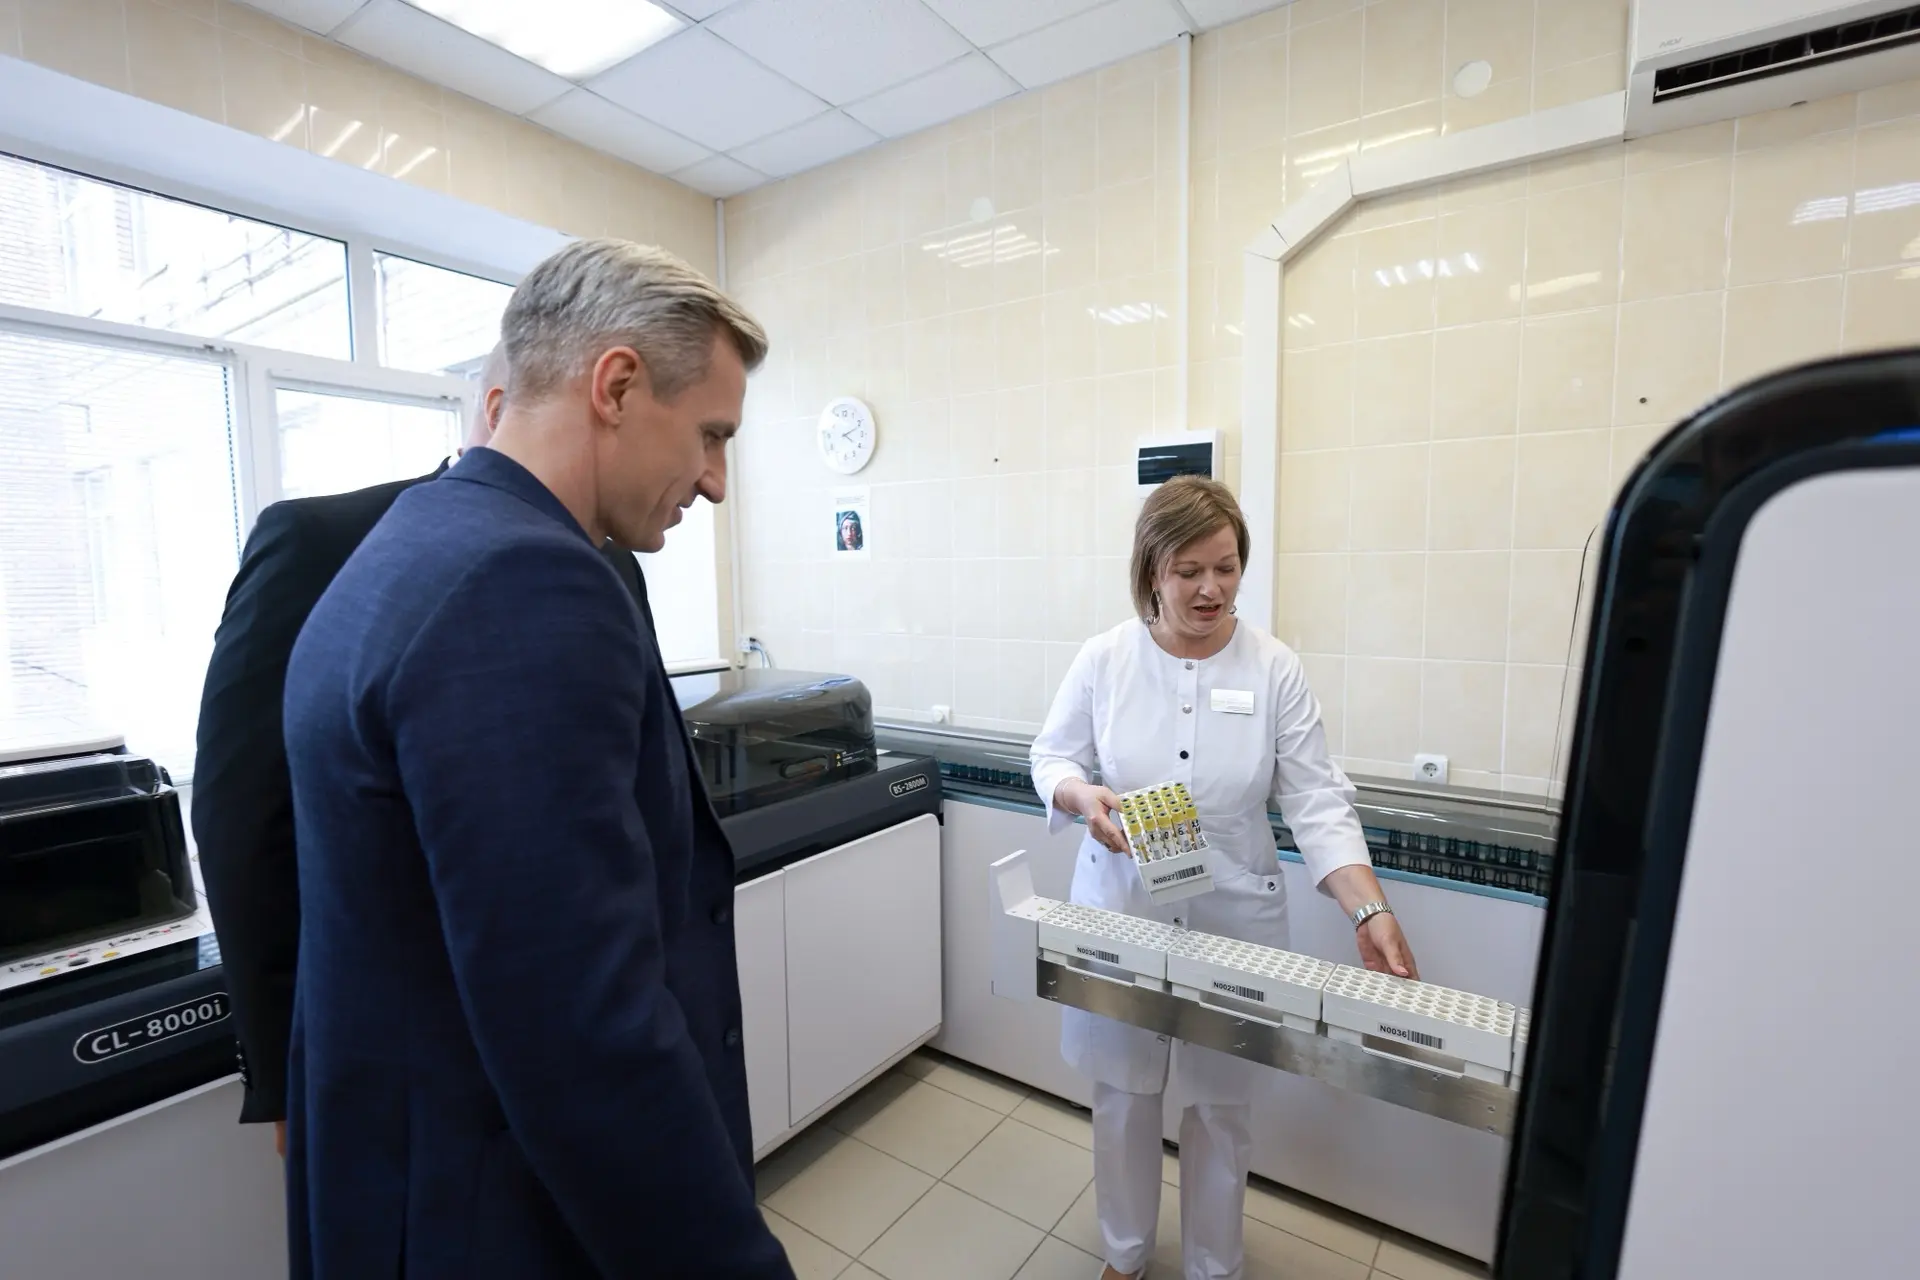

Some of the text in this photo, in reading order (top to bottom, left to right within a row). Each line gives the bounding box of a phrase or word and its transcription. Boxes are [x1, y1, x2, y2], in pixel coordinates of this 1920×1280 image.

[893, 777, 927, 795] BS-2800M
[1153, 873, 1175, 885] N0027
[1213, 981, 1236, 993] N0022
[91, 999, 222, 1054] CL-8000i
[1380, 1024, 1407, 1038] N0036
